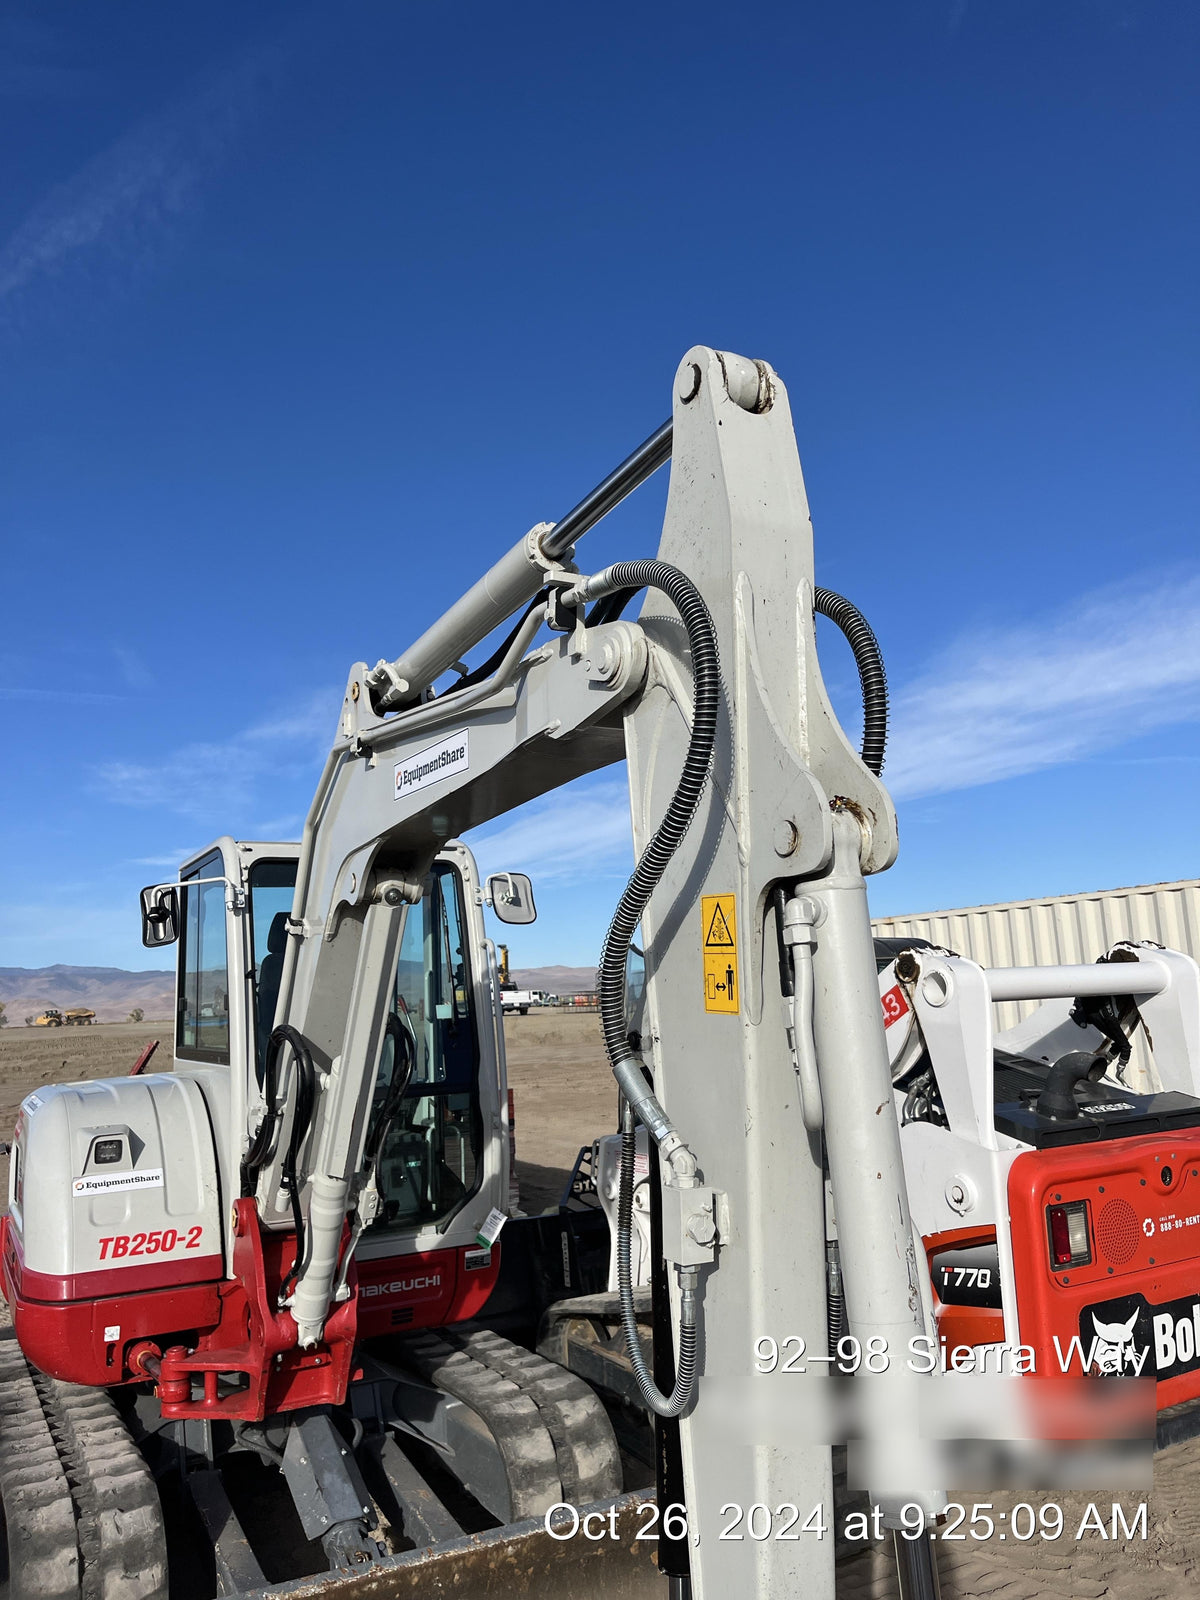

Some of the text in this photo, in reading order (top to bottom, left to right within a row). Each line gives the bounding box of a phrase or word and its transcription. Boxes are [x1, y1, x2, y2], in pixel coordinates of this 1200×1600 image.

[403, 746, 465, 785] EquipmentShare
[85, 1174, 161, 1189] EquipmentShare
[98, 1226, 203, 1260] TB250-2
[941, 1267, 991, 1288] T770
